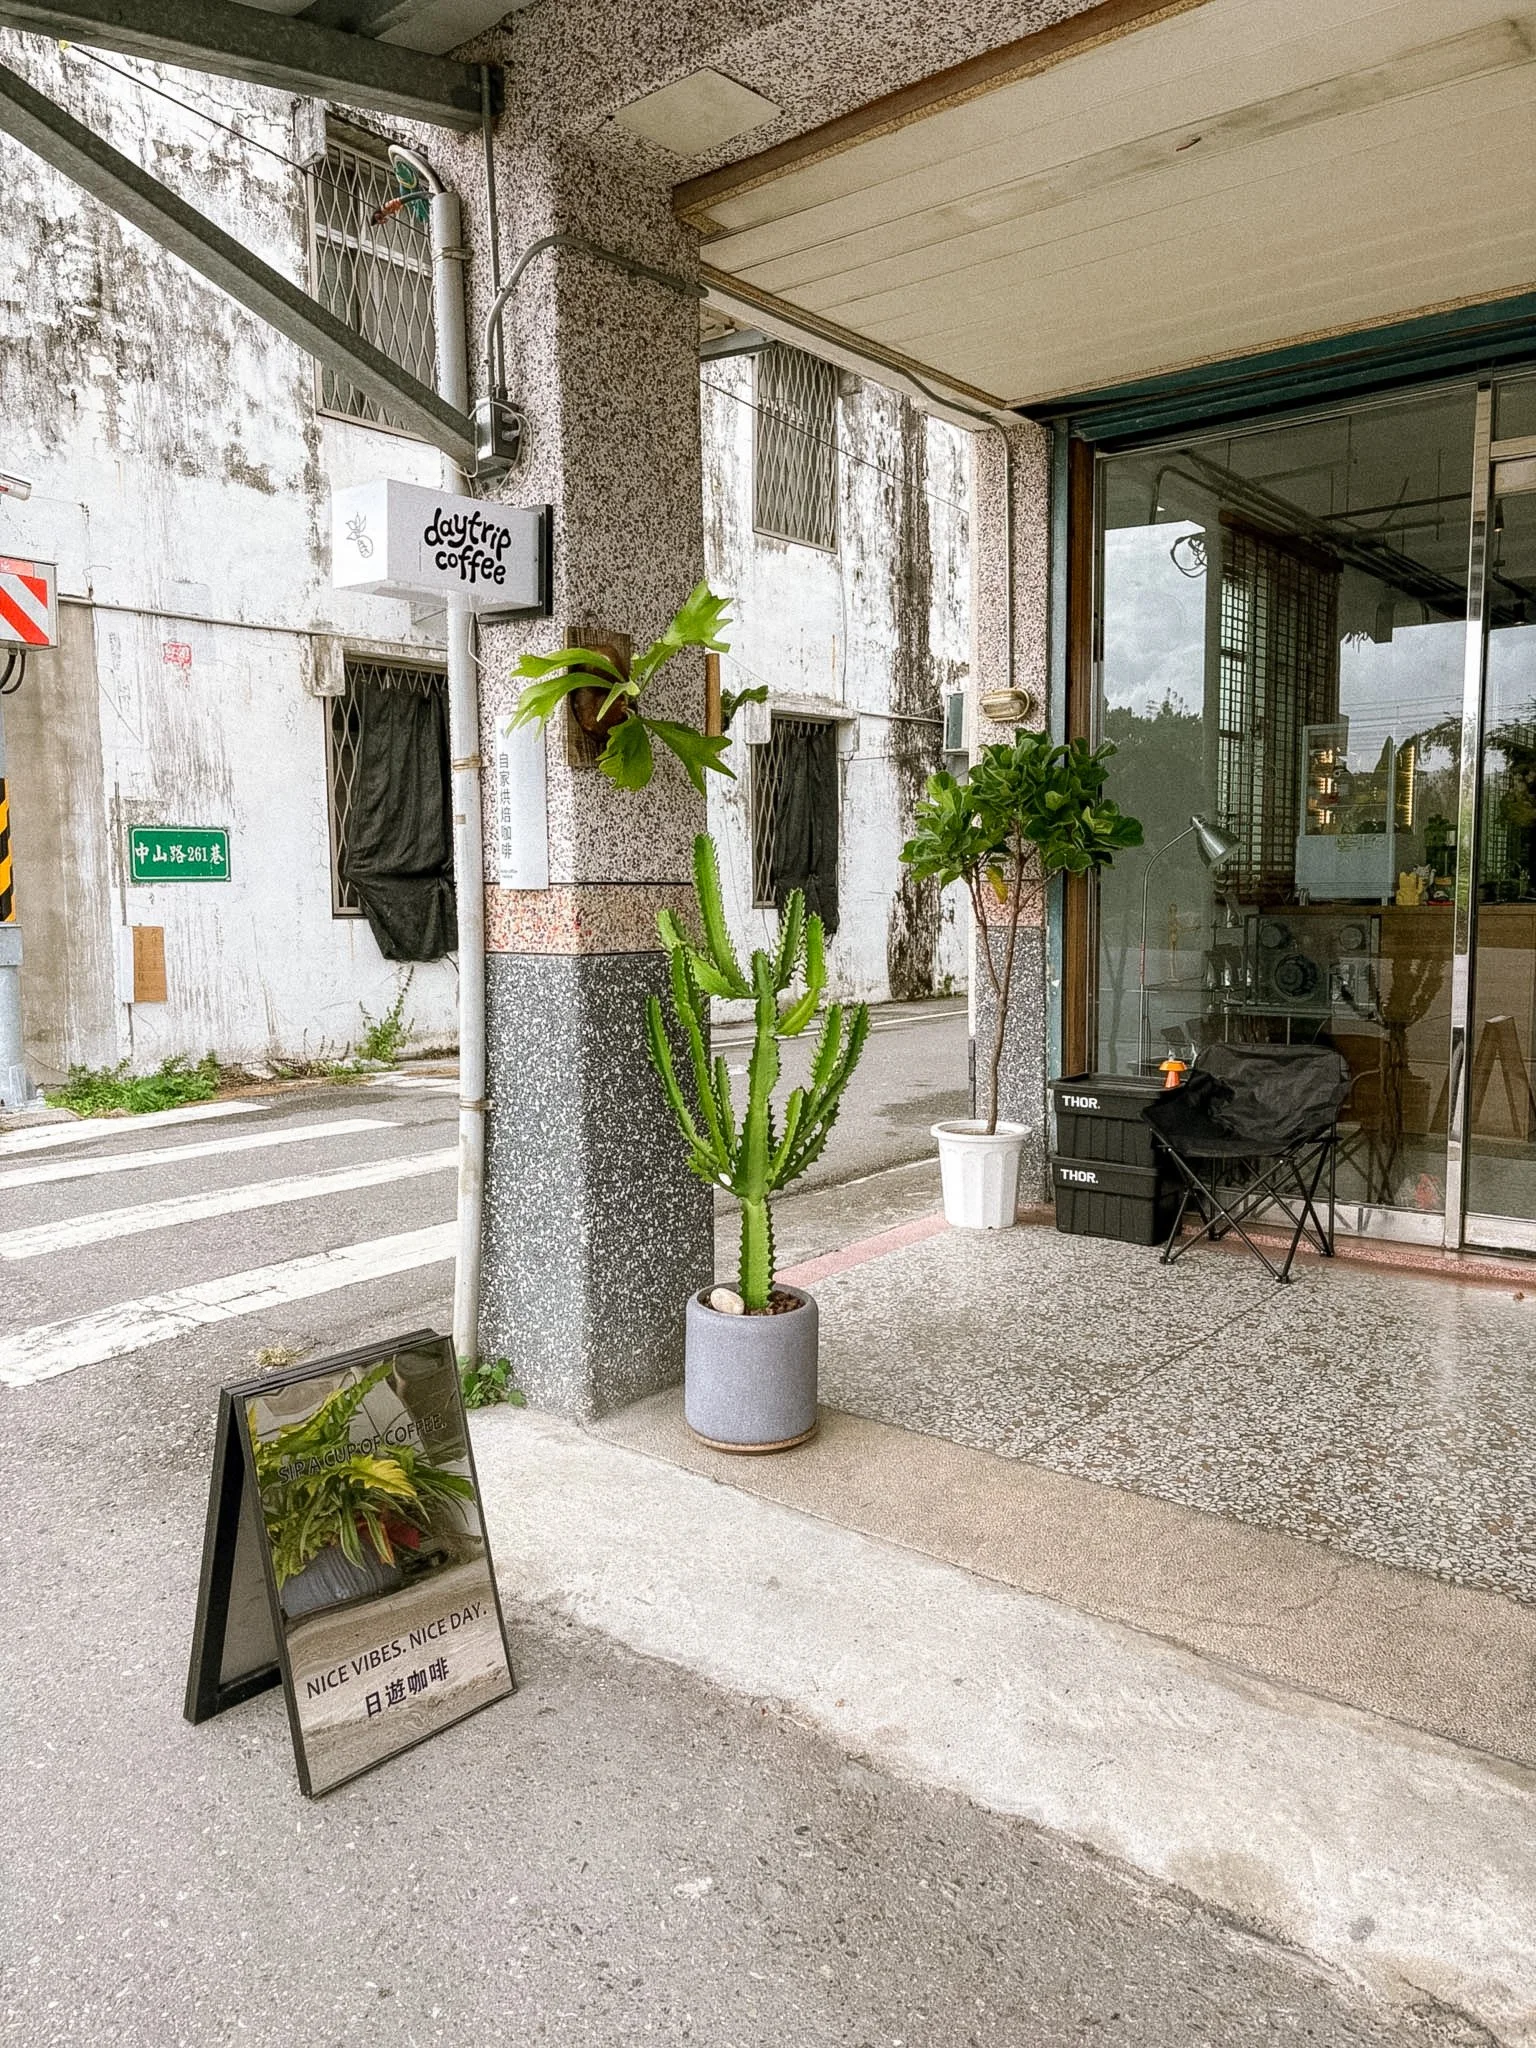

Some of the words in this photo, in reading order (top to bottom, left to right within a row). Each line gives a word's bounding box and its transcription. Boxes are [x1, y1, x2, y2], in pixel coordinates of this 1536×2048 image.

[424, 507, 512, 562] daytrip
[435, 545, 506, 585] coffee
[134, 841, 225, 865] 中山路261巷
[1061, 1094, 1101, 1110] THOR.
[1060, 1168, 1099, 1184] THOR.
[278, 1461, 306, 1485] SIP
[308, 1457, 322, 1475] A
[324, 1444, 357, 1468] CUP
[360, 1434, 382, 1455] OF
[385, 1413, 448, 1447] COFFEE.
[306, 1664, 350, 1699] NICE
[351, 1639, 407, 1677] VIBES.
[409, 1618, 448, 1649] NICE
[450, 1602, 487, 1630] DAY.
[365, 1656, 450, 1718] 日遊咖啡
